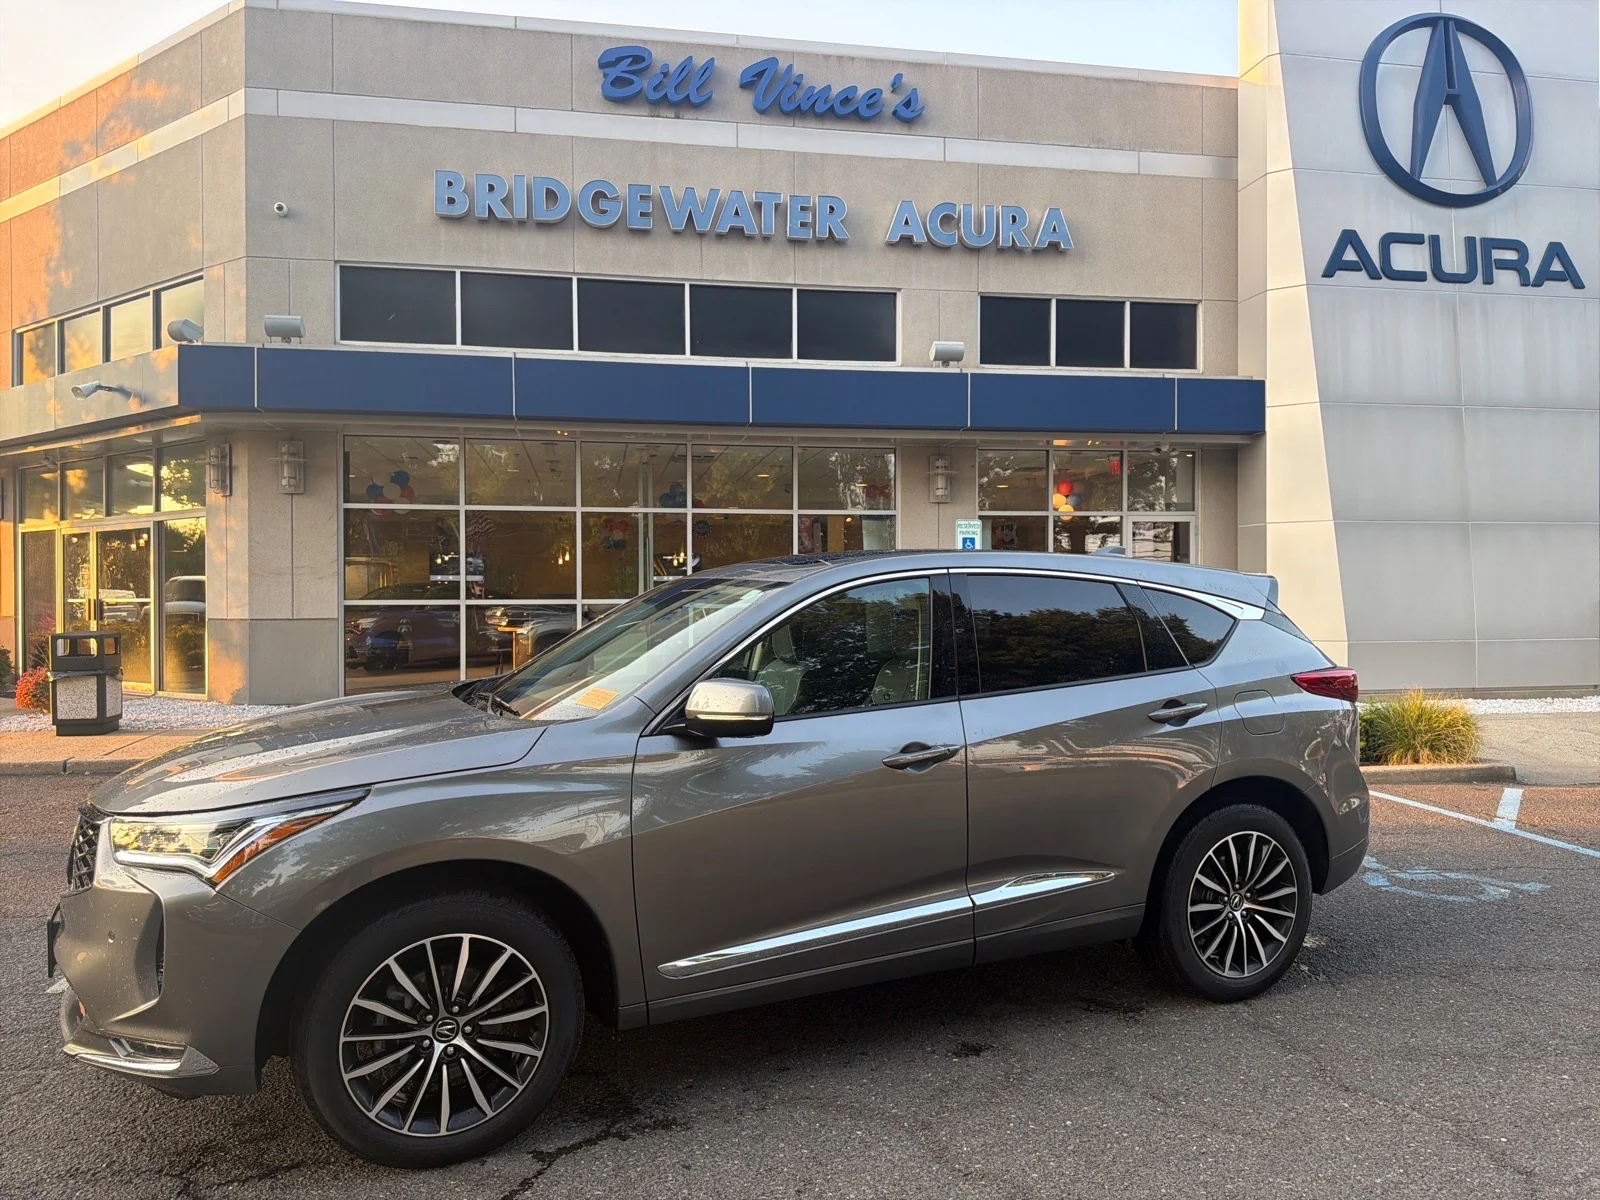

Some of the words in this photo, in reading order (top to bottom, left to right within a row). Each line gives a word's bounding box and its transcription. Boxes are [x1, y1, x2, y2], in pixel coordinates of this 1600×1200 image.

[598, 45, 715, 108] Bill
[739, 57, 926, 123] Vince's
[433, 169, 850, 242] BRIDGEWATER
[885, 200, 1075, 251] ACURA
[1321, 229, 1586, 290] ACURA
